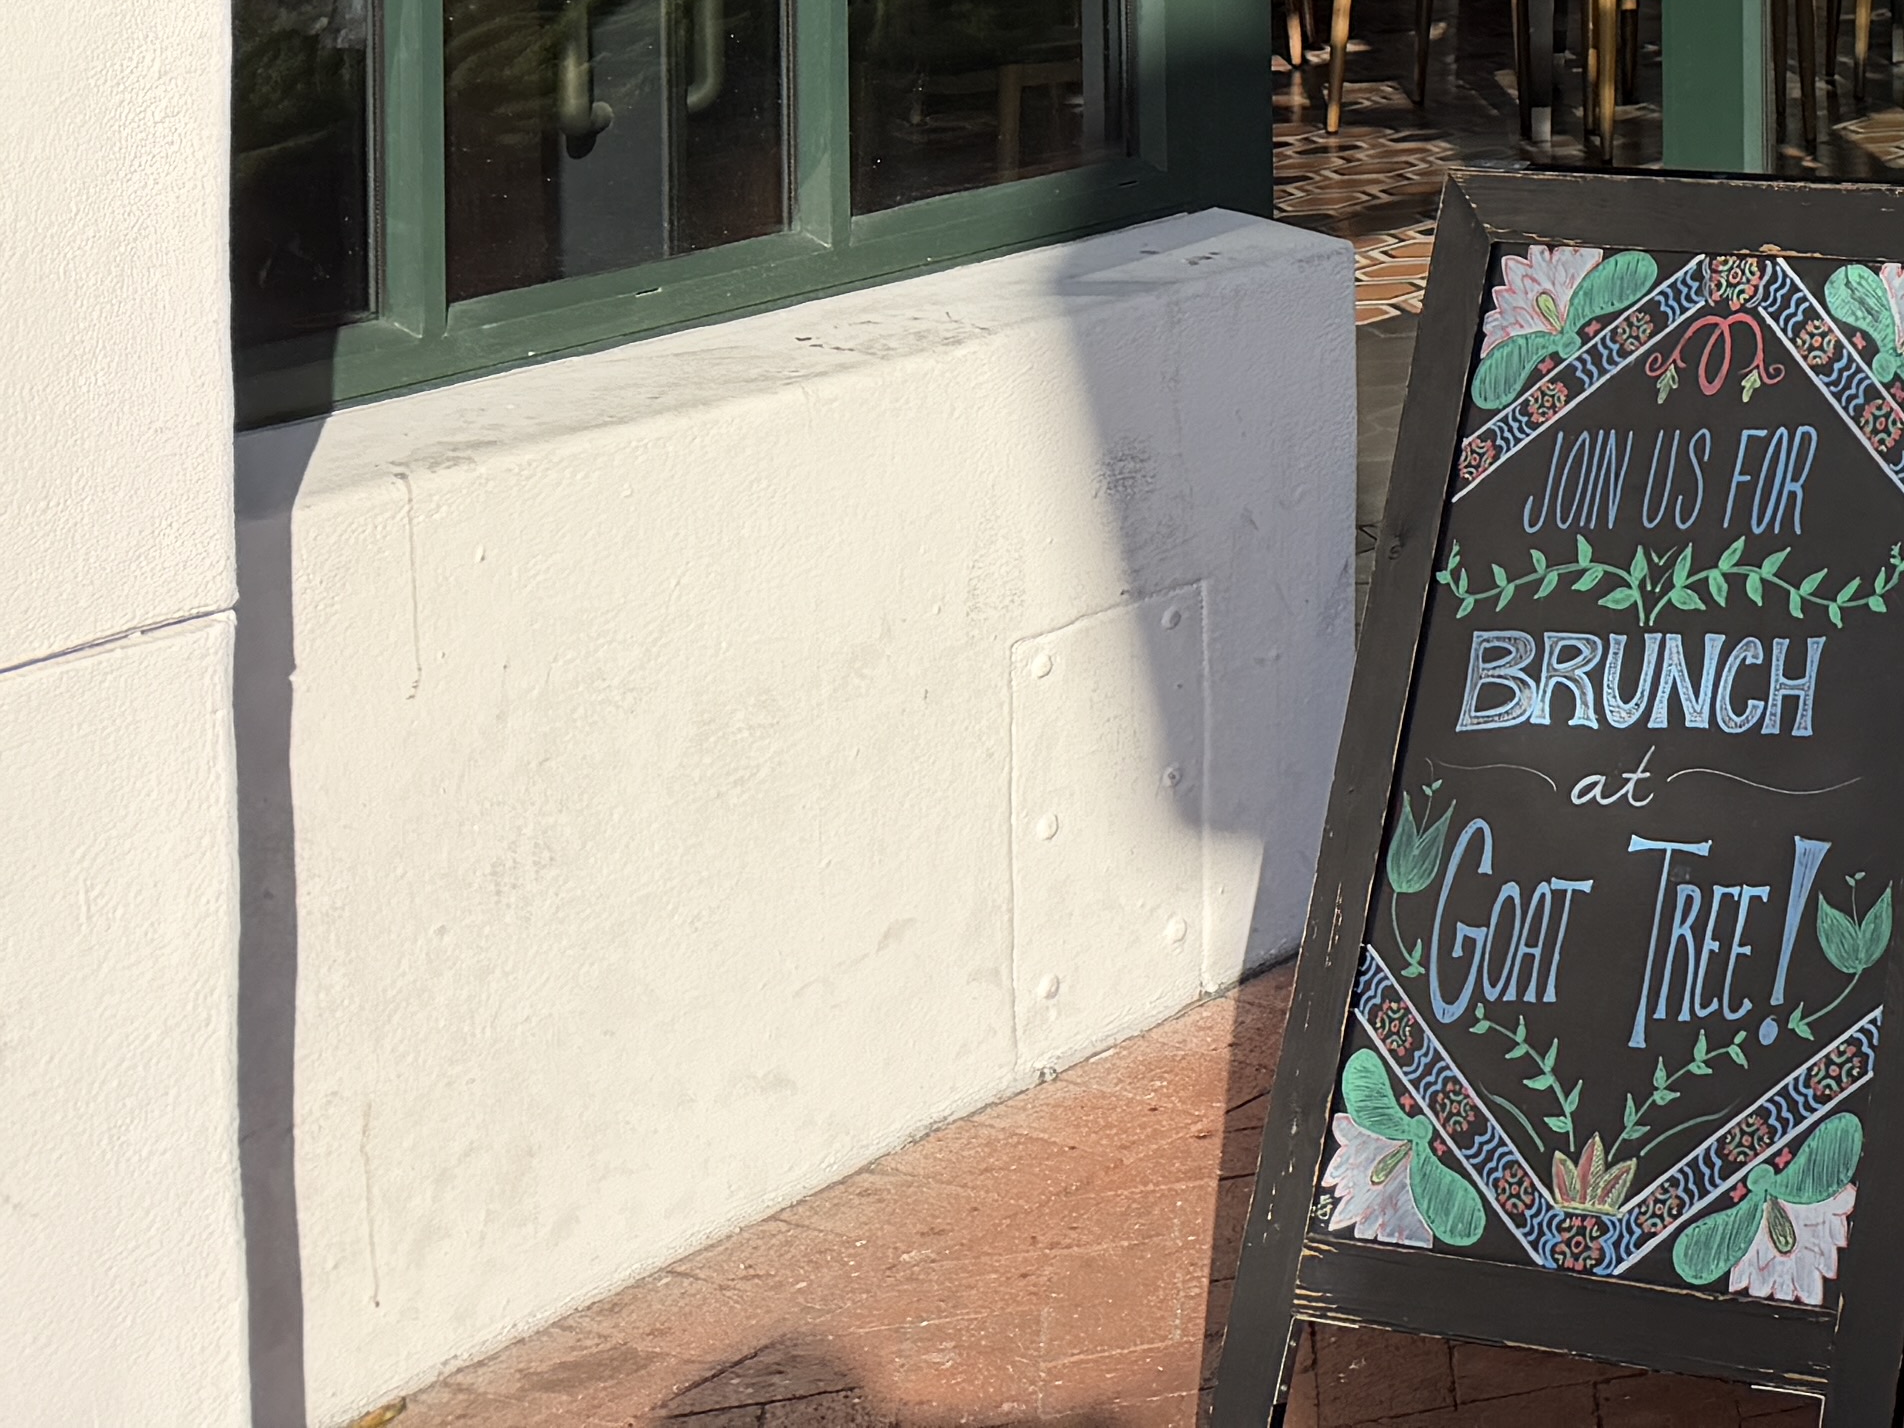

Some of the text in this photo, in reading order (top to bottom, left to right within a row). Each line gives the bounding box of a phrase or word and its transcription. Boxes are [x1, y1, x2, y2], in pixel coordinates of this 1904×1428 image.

[1522, 424, 1819, 535] JOIN US FOR
[1455, 629, 1828, 737] BRUNCH
[1570, 744, 1656, 808] at
[1428, 817, 1832, 1049] GOAT TREE!
